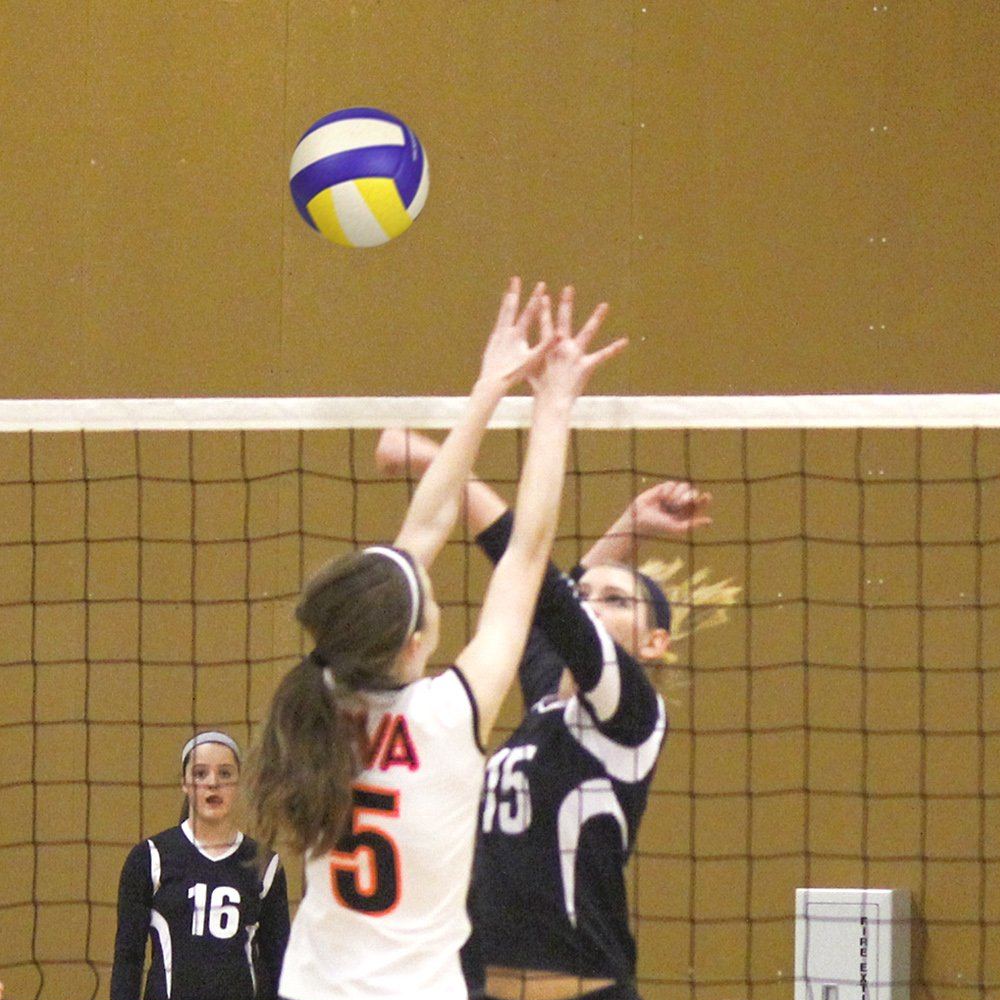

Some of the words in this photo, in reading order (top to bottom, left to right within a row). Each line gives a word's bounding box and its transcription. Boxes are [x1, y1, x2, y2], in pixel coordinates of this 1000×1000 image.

[482, 744, 538, 835] 15
[329, 783, 401, 917] 5
[187, 882, 241, 940] 16
[859, 916, 868, 958] FIRE
